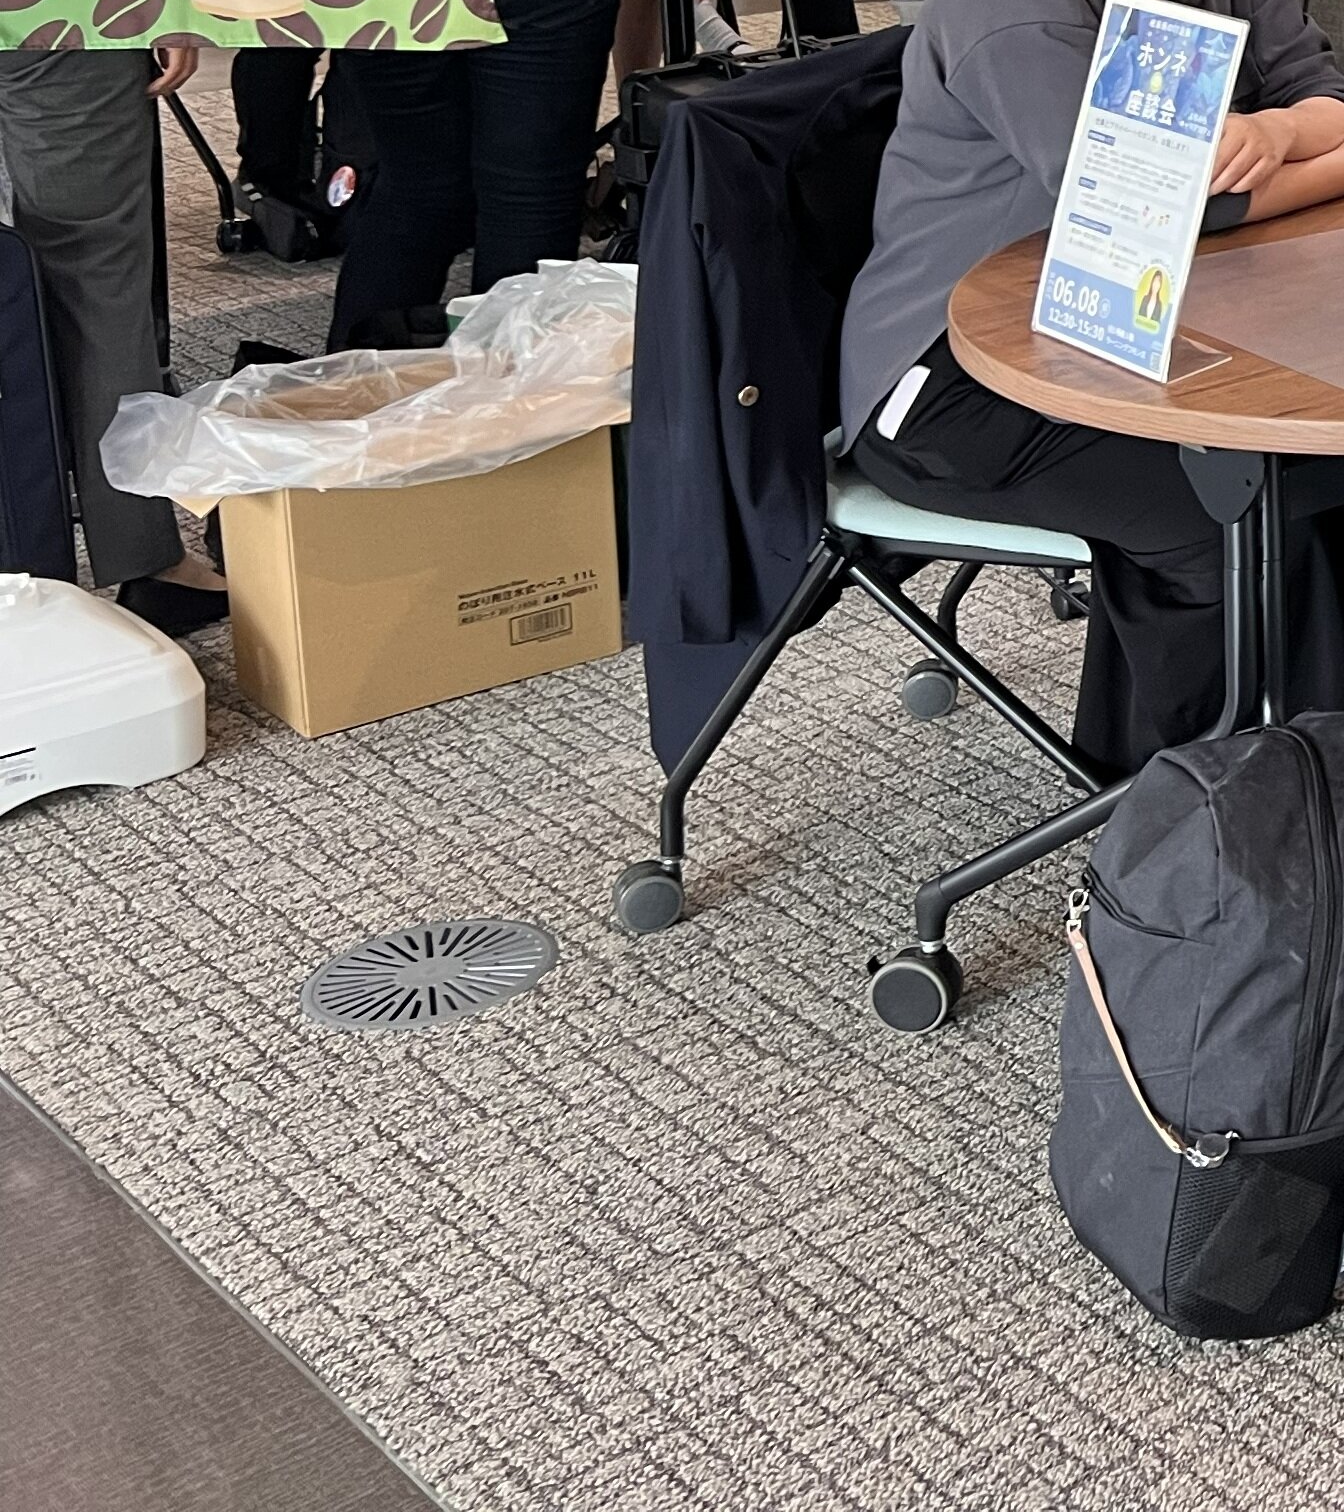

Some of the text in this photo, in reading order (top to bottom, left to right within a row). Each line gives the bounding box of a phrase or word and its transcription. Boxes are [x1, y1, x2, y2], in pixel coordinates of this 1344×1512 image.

[1137, 41, 1188, 77] ホンネ
[1125, 89, 1176, 126] 座談会
[1053, 276, 1100, 317] 06.08
